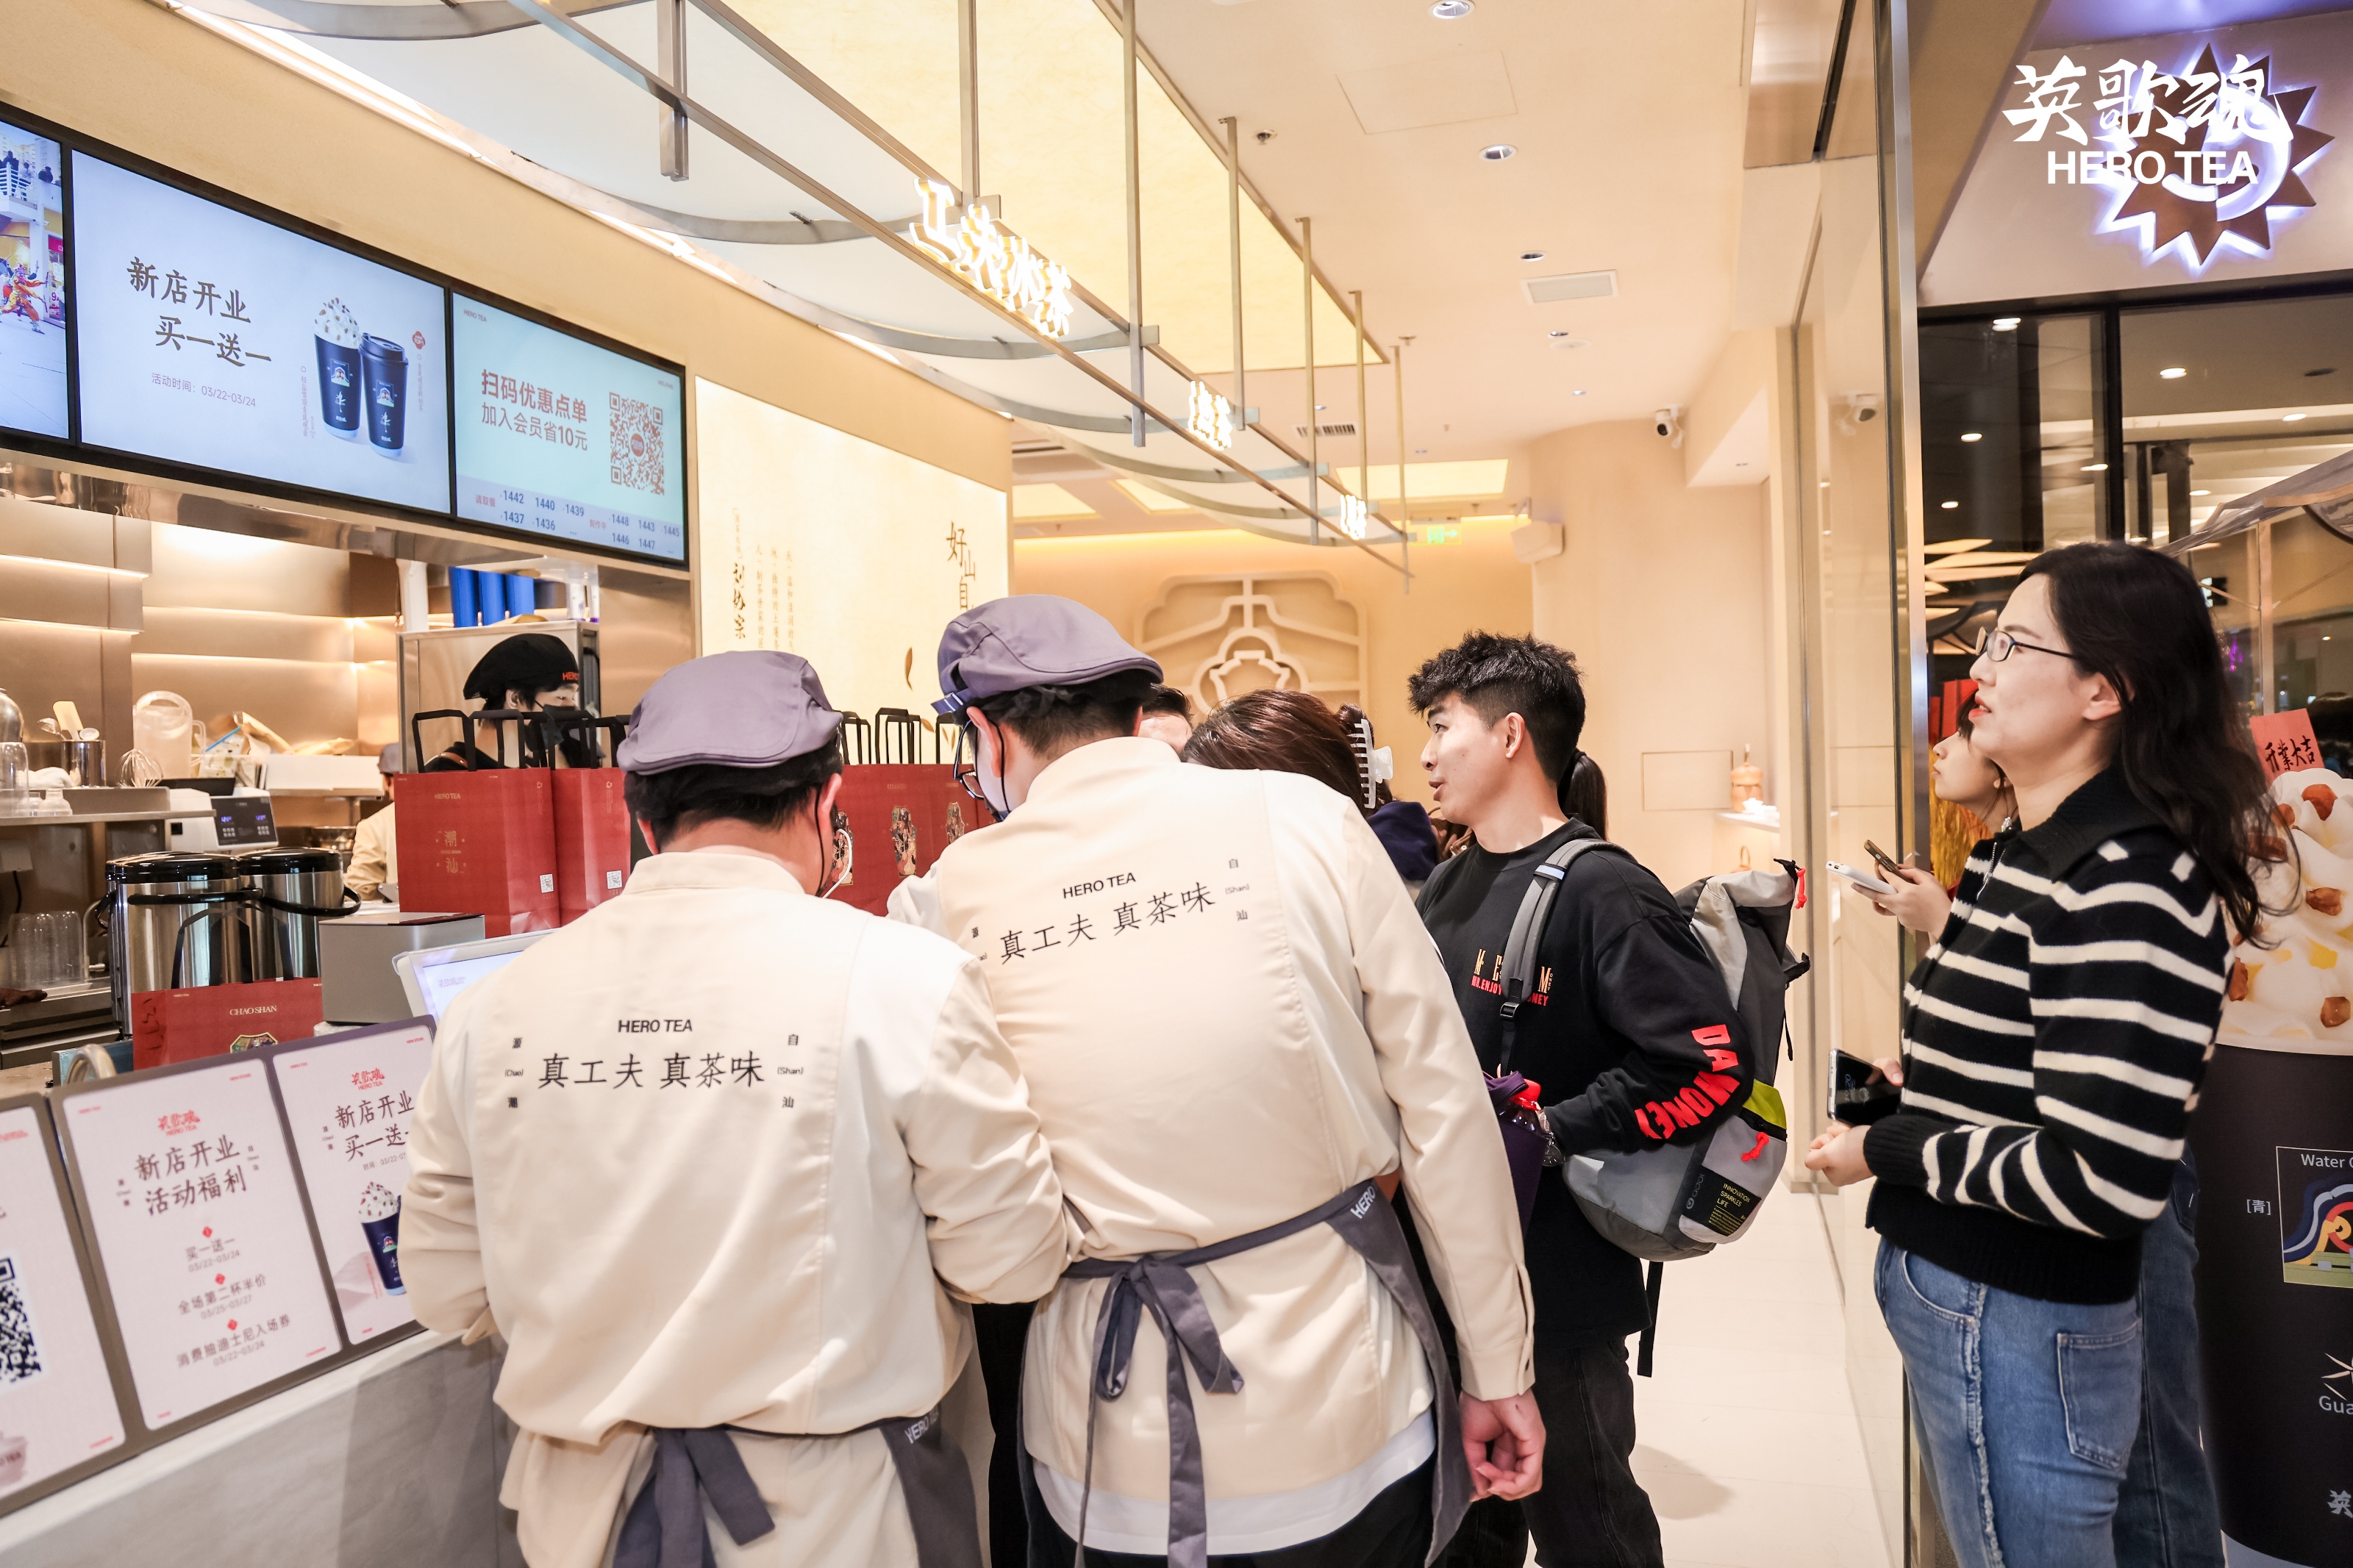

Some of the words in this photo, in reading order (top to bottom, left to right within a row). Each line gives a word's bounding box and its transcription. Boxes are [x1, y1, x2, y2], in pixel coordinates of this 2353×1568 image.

[126, 256, 251, 323] 新店开业
[155, 315, 271, 367] 买一送一
[482, 369, 588, 423] 扫码优惠点单
[482, 401, 588, 451] 加入会员省10元
[503, 490, 524, 504] 1442
[535, 497, 555, 511] 1440
[565, 504, 584, 517] 1439
[504, 511, 524, 524] 1437
[535, 518, 555, 531] 1436
[612, 514, 629, 526] 1448
[638, 519, 655, 531] 1443
[663, 526, 679, 537] 1445
[612, 533, 629, 545] 1446
[638, 538, 655, 550] 1447
[1063, 880, 1104, 899] HERO
[1107, 872, 1137, 889] TEA
[999, 914, 1097, 965] 真工夫
[1113, 881, 1216, 937] 真茶味
[229, 1006, 254, 1017] CHAO
[254, 1005, 277, 1014] SHAN
[617, 1019, 661, 1033] HERO
[664, 1019, 693, 1032] TEA
[504, 1068, 524, 1078] (Chao)
[538, 1052, 644, 1089] 真工夫
[660, 1050, 765, 1089] 真茶味
[777, 1066, 804, 1076] (Shan)
[358, 1083, 372, 1091] HERO
[335, 1090, 415, 1128] 新店开业
[782, 1096, 794, 1109] 汕
[345, 1123, 409, 1162] 买一送
[135, 1134, 240, 1181] 新店开业
[2301, 1153, 2346, 1168] Water
[146, 1165, 246, 1216] 活动福利
[1721, 1191, 1743, 1207] SPARKLES
[1723, 1183, 1751, 1203] INNOVATION
[1350, 1186, 1377, 1219] HERO
[1717, 1198, 1729, 1209] LIFE
[2246, 1199, 2271, 1216] [青]
[186, 1238, 235, 1261] 买一送一
[178, 1273, 266, 1315] 全场第二杯半价
